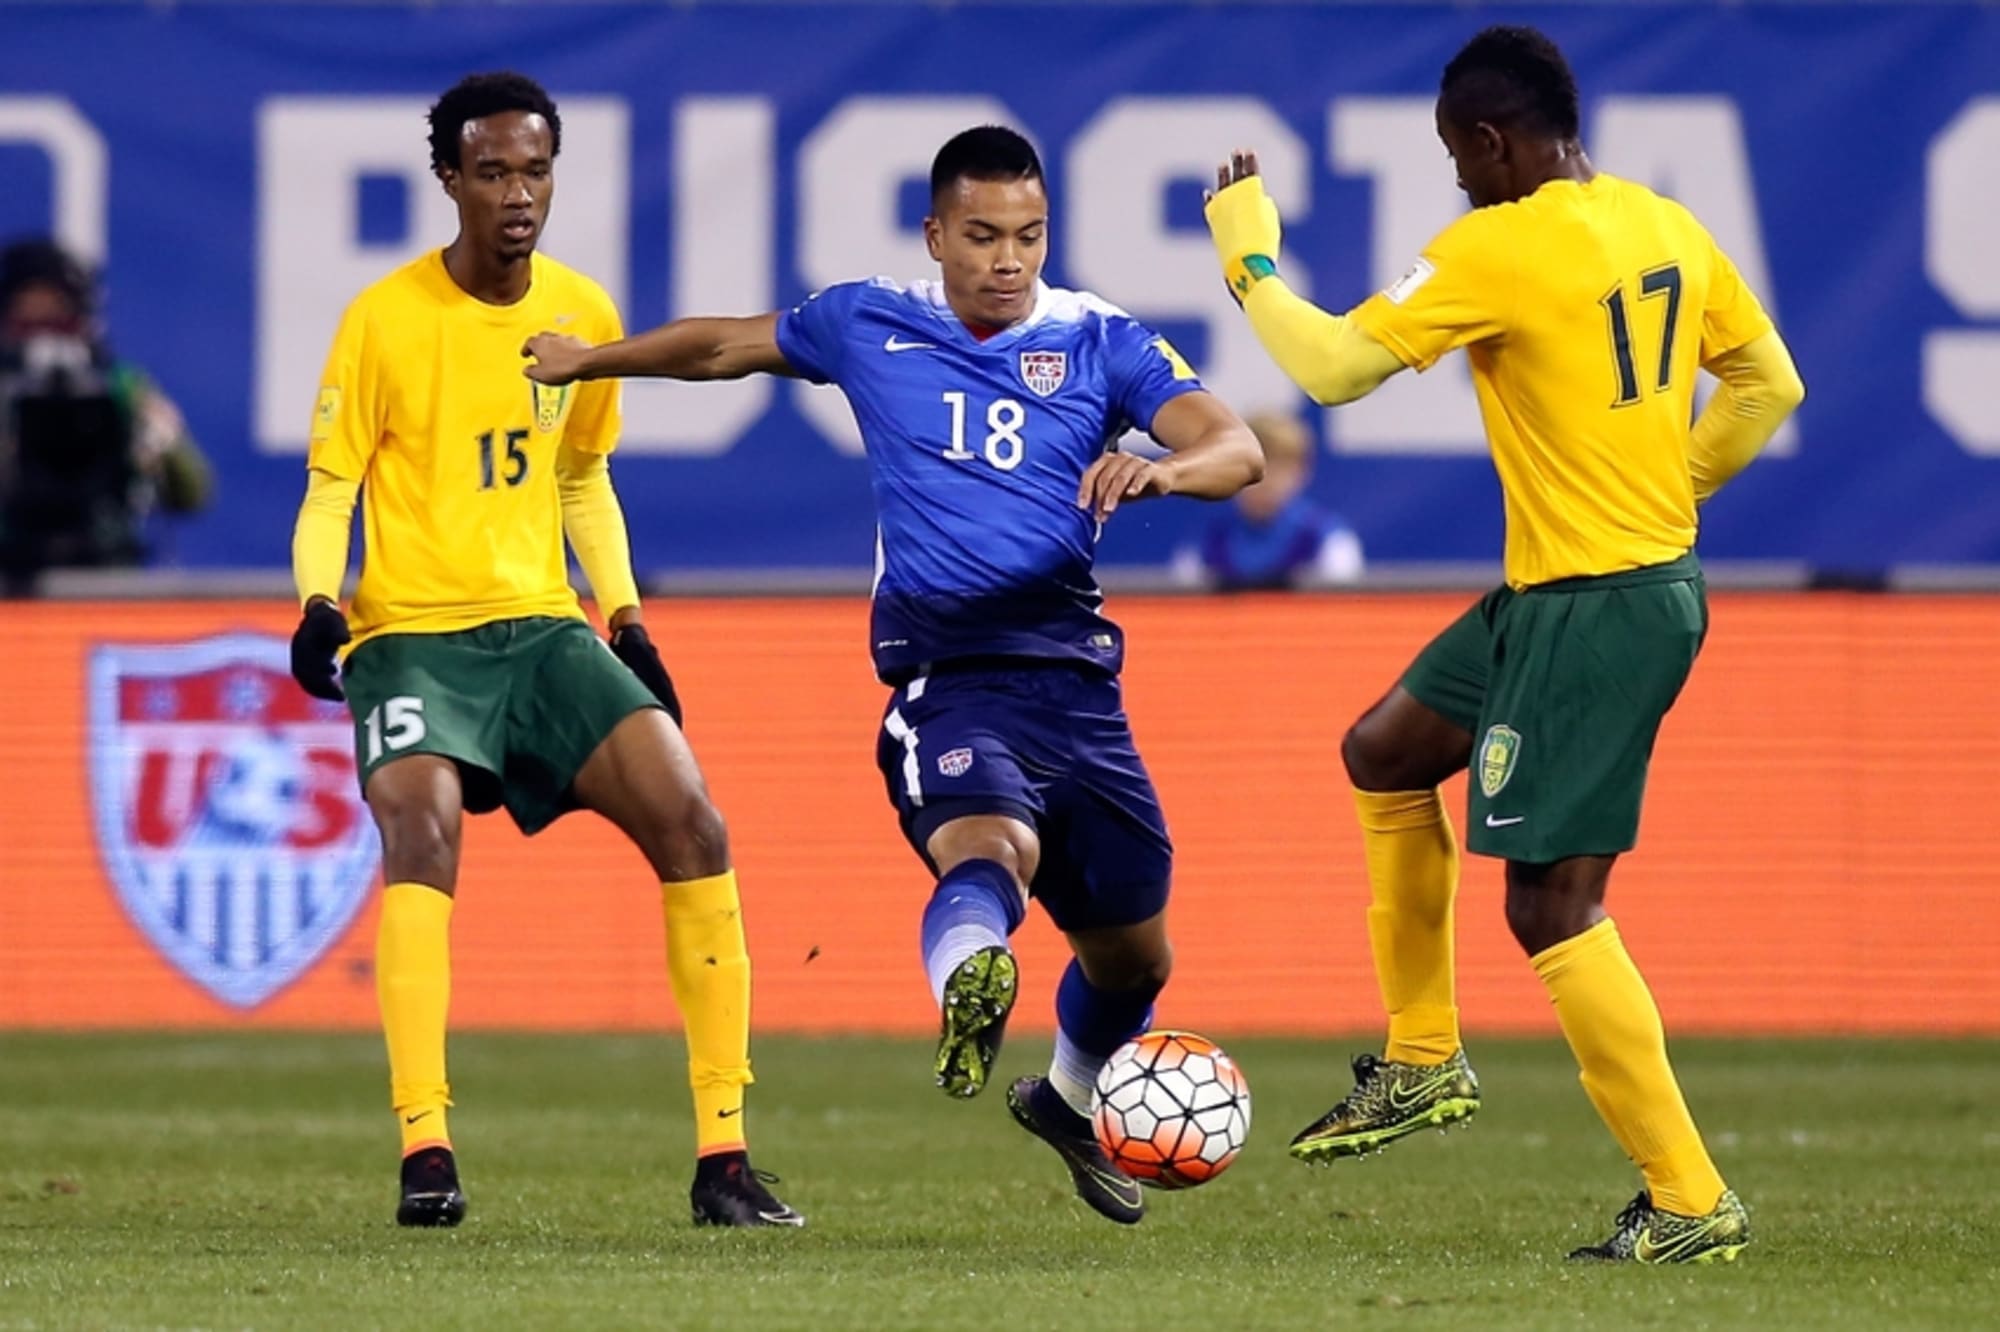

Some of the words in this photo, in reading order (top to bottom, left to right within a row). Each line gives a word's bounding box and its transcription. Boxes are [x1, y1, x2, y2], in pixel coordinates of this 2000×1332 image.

[1598, 260, 1681, 410] 17
[475, 427, 530, 492] 15
[942, 391, 1026, 472] 18
[364, 695, 428, 767] 15
